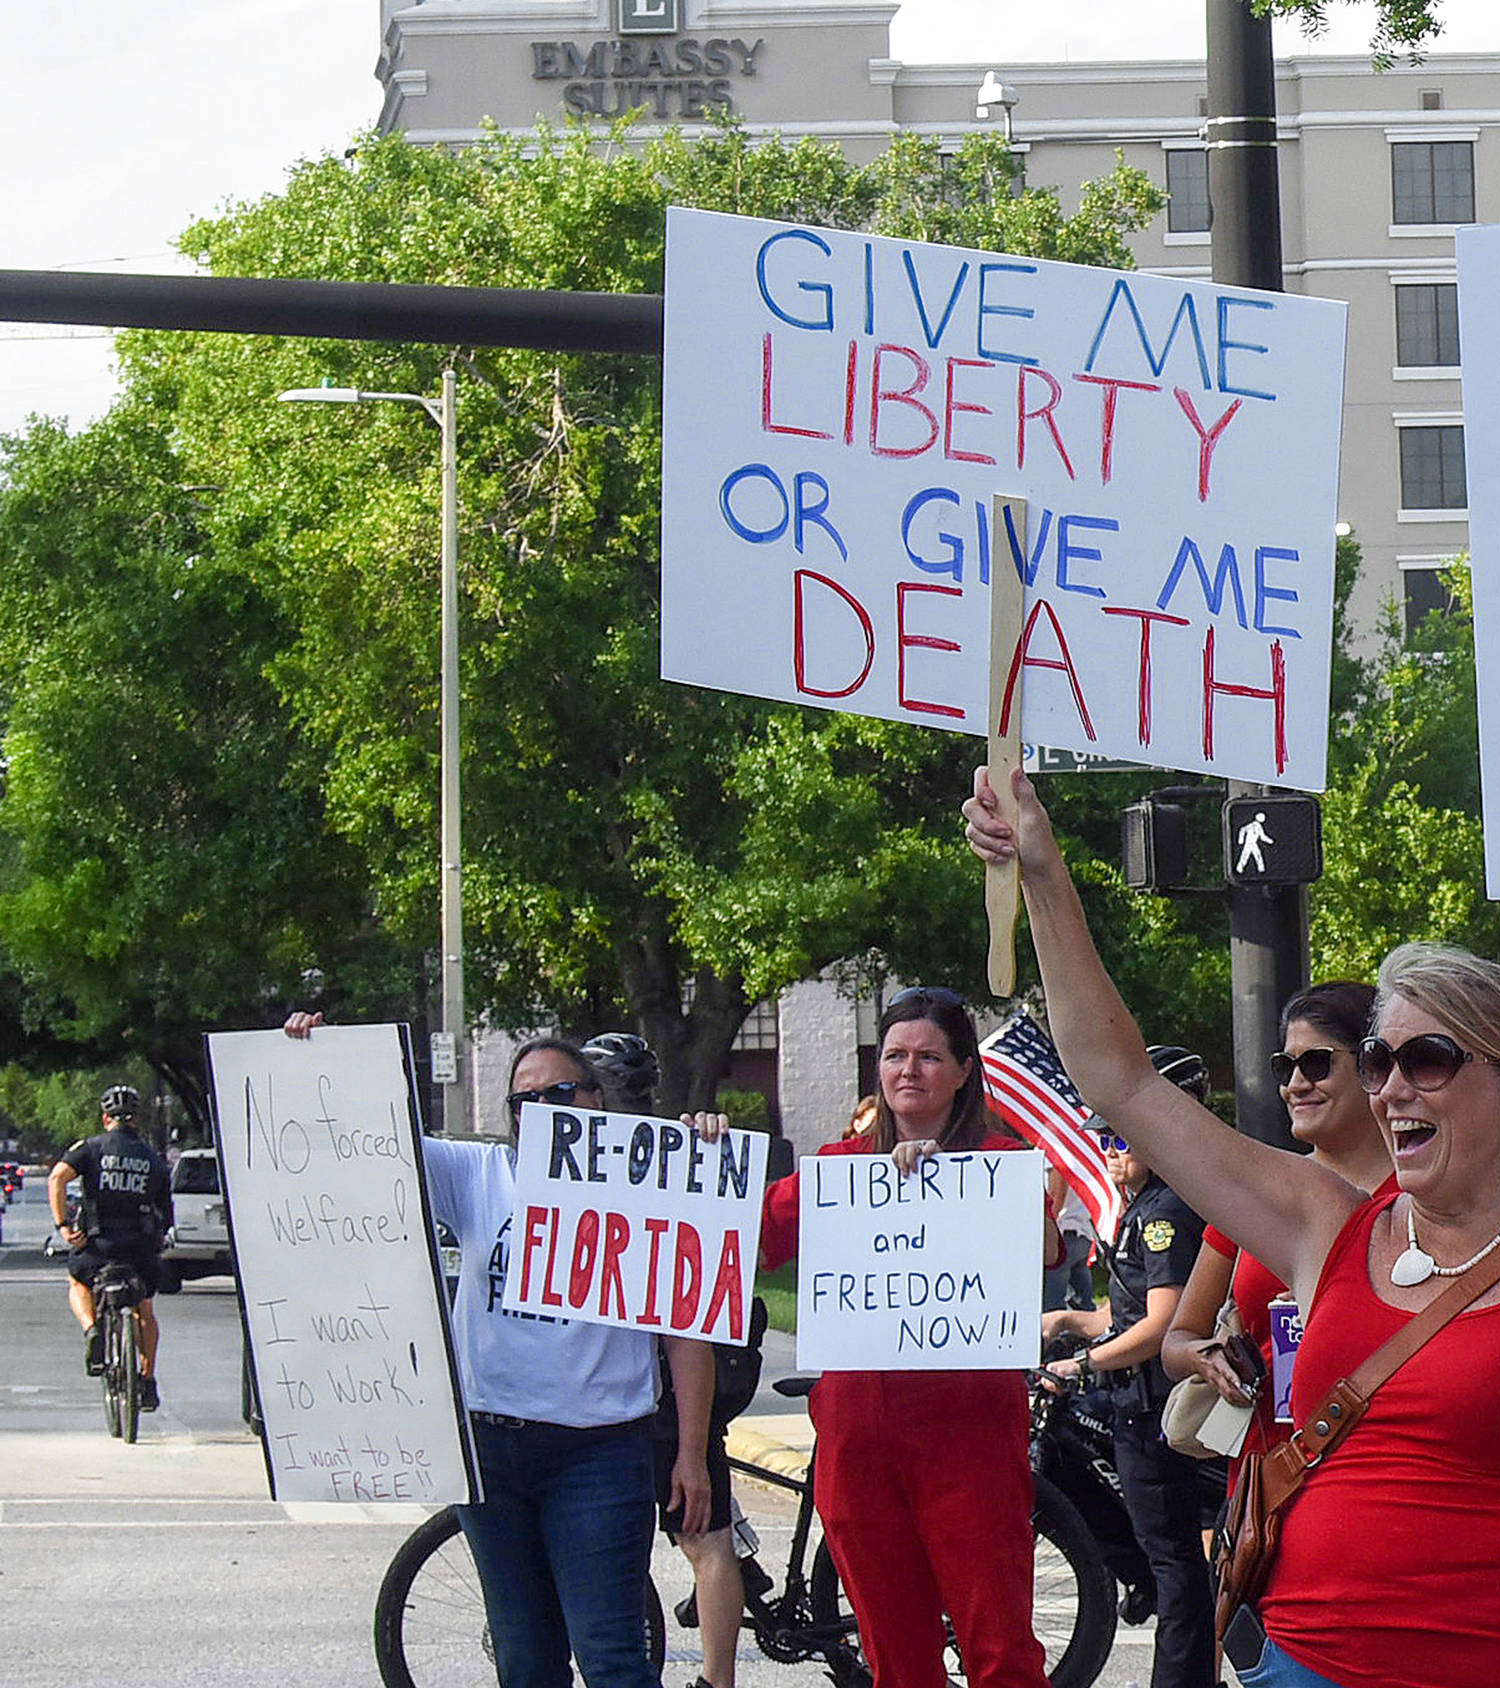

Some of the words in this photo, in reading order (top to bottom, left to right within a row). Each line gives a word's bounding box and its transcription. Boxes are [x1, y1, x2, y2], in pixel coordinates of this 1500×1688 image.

[531, 38, 764, 80] EMBASSY
[563, 79, 733, 119] SUITES
[757, 229, 1040, 367] GIVE
[1085, 278, 1277, 401] ME
[761, 332, 1243, 503] LIBERTY
[719, 462, 848, 563] OR
[901, 487, 1120, 599] GIVE
[1156, 535, 1302, 640] ME
[794, 569, 1290, 778] DEATH
[245, 1072, 311, 1174] No
[315, 1074, 412, 1168] forced
[101, 1154, 150, 1173] ORLANDO
[548, 1111, 751, 1200] RE-OPEN
[99, 1171, 150, 1194] POLICE
[816, 1155, 1002, 1209] LIBERTY
[873, 1223, 926, 1253] and
[519, 1205, 743, 1341] FLORIDA
[813, 1271, 987, 1313] FREEDOM
[257, 1298, 297, 1345] I
[311, 1282, 390, 1343] want
[276, 1362, 315, 1410] to
[275, 1433, 305, 1470] I
[308, 1435, 351, 1468] want
[361, 1434, 390, 1468] to
[395, 1435, 432, 1468] be
[330, 1470, 437, 1501] FREE!!
